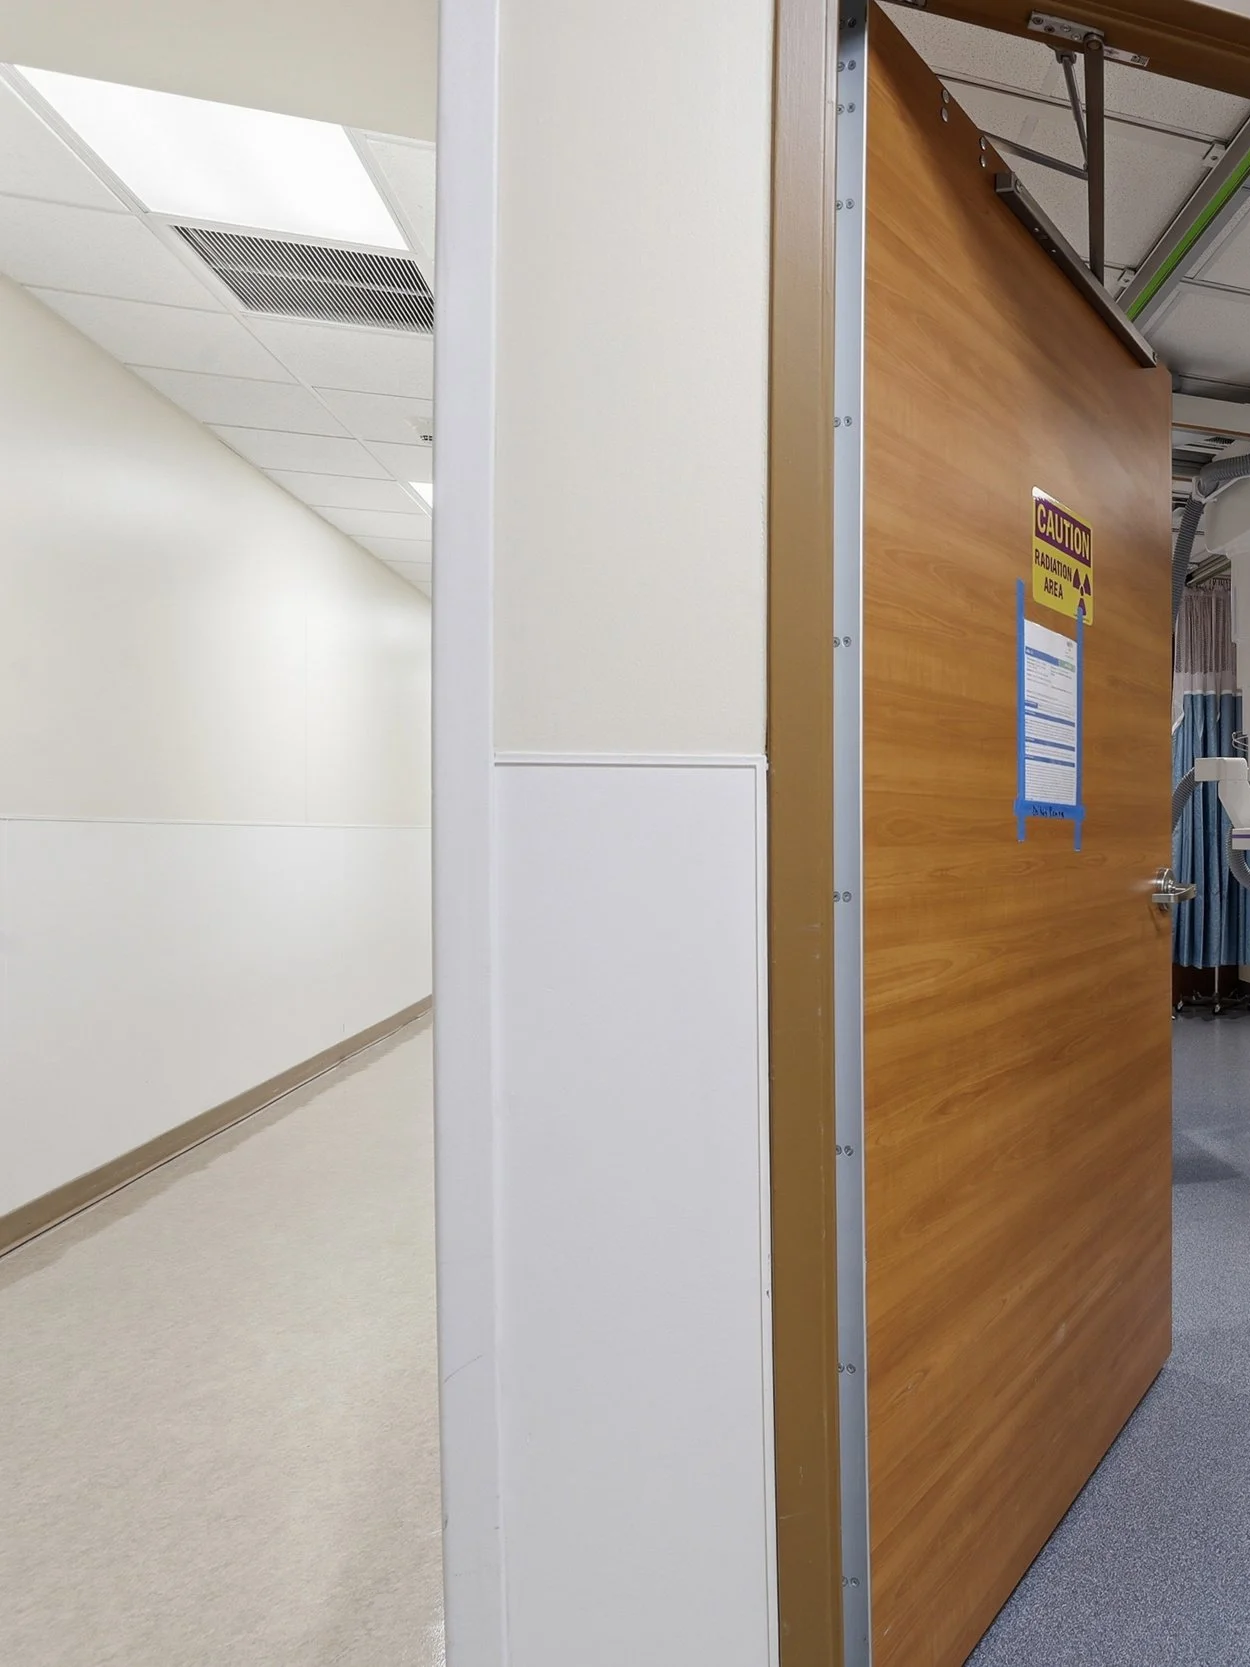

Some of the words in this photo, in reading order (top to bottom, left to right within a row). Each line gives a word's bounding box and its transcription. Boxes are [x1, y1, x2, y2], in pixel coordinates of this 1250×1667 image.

[1037, 503, 1090, 560] CAUTION
[1034, 549, 1072, 582] RADIATION
[1043, 577, 1064, 600] AREA
